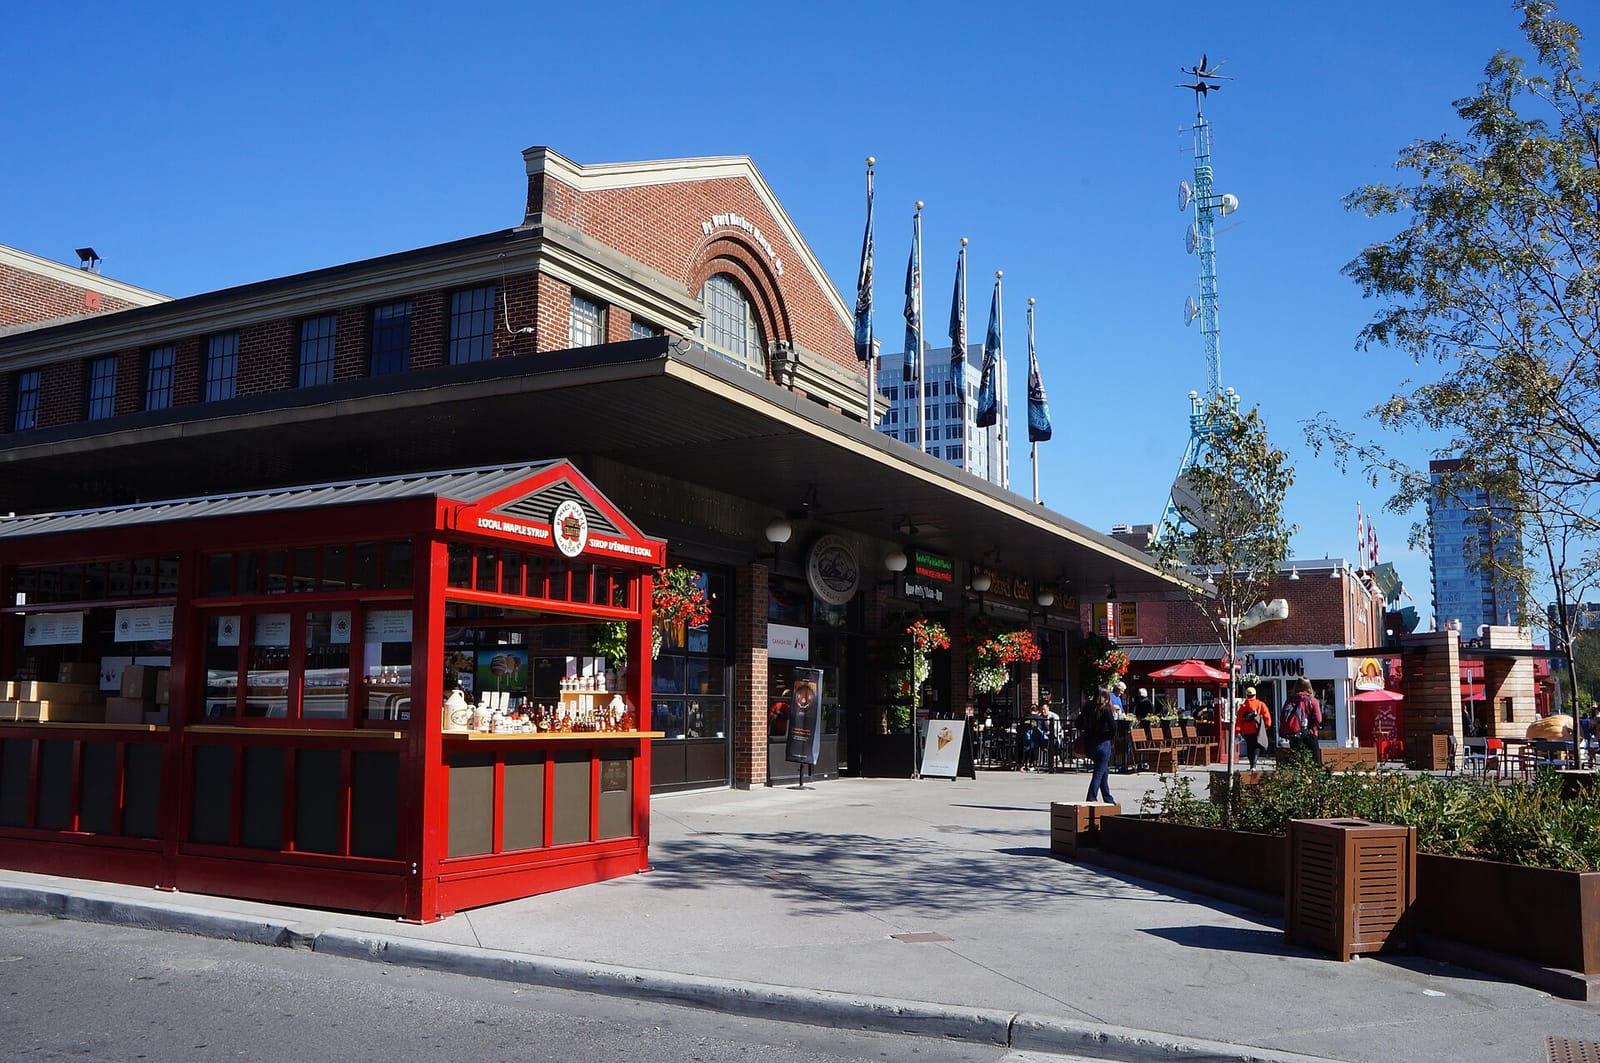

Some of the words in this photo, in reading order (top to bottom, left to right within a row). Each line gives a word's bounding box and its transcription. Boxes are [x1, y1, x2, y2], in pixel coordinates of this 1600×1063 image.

[478, 517, 501, 531] LOCAL
[502, 521, 526, 535] MAPLE
[526, 527, 549, 539] SYRUP
[589, 539, 608, 550] SIROP
[635, 546, 652, 558] LOCAL
[1245, 653, 1305, 677] FLUEVOG
